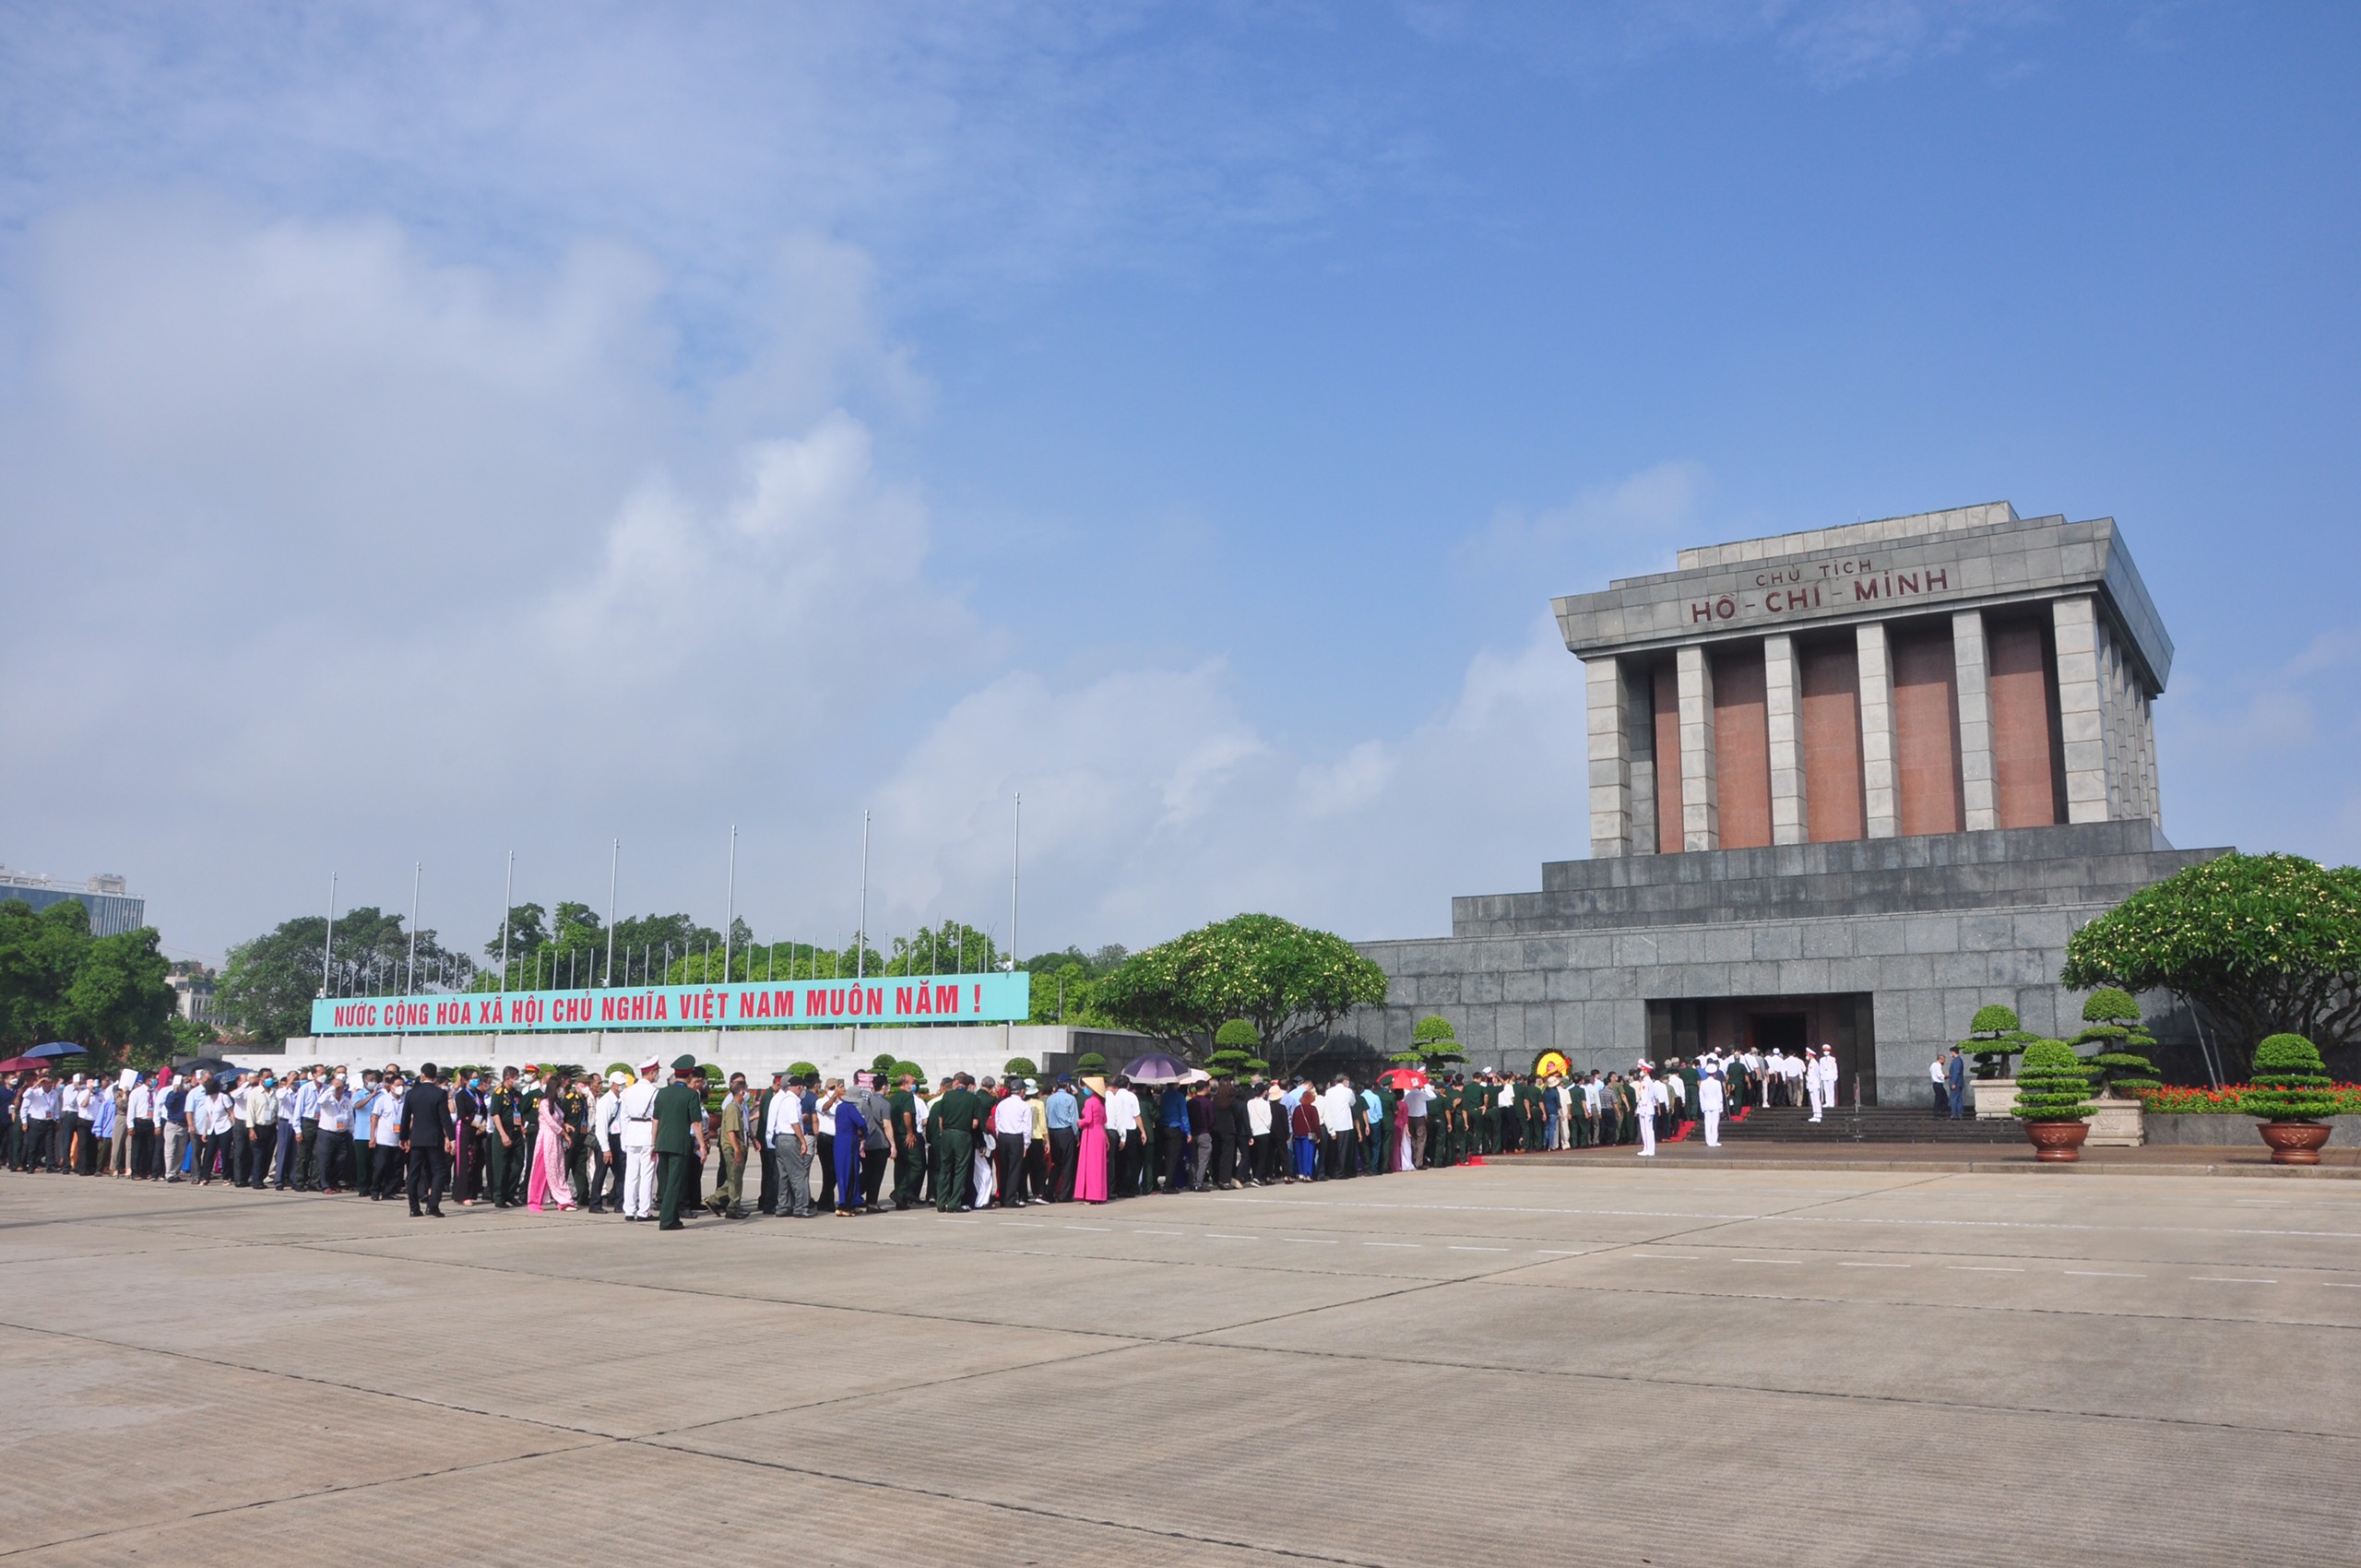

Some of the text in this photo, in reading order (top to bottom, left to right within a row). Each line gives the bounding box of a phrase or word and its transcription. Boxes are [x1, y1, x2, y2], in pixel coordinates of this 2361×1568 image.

[1756, 565, 1799, 587] CHỦ
[335, 1001, 377, 1028] NƯỚC
[384, 1001, 430, 1030] CỘNG
[436, 1001, 472, 1026] HÒA
[479, 996, 504, 1025] XÃ
[512, 995, 545, 1028] HỘI
[552, 991, 593, 1023] CHỦ
[601, 991, 669, 1021] NGHĨA
[680, 988, 730, 1025] VIỆT
[739, 990, 795, 1019] NAM
[805, 982, 884, 1017] MUÔN
[896, 980, 959, 1016] NĂM
